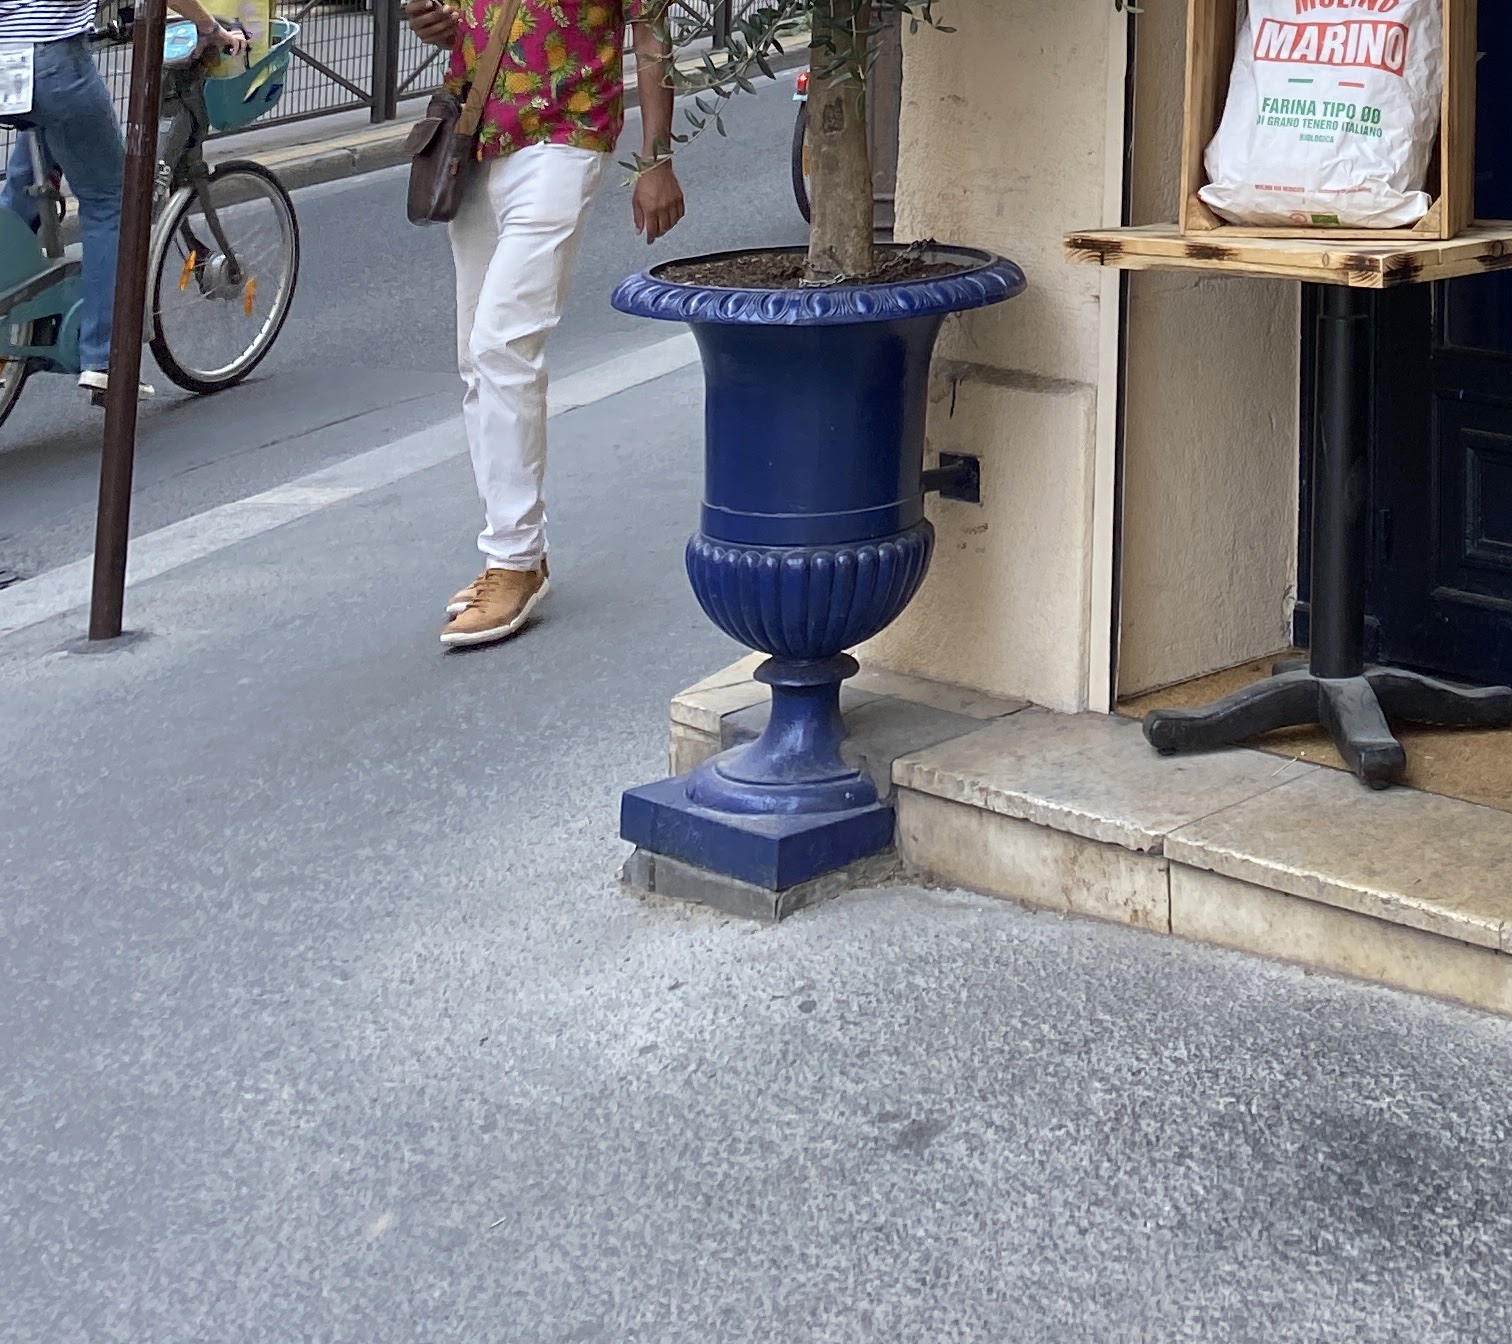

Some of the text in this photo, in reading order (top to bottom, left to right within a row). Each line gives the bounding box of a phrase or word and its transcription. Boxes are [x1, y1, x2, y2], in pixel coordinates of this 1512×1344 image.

[1256, 20, 1406, 71] MARINO
[1261, 96, 1317, 117] FARINA
[1322, 100, 1357, 120] TIPO
[1267, 115, 1300, 128] GRANO
[1302, 118, 1339, 132] TENERO
[1341, 121, 1383, 138] ITALIANO
